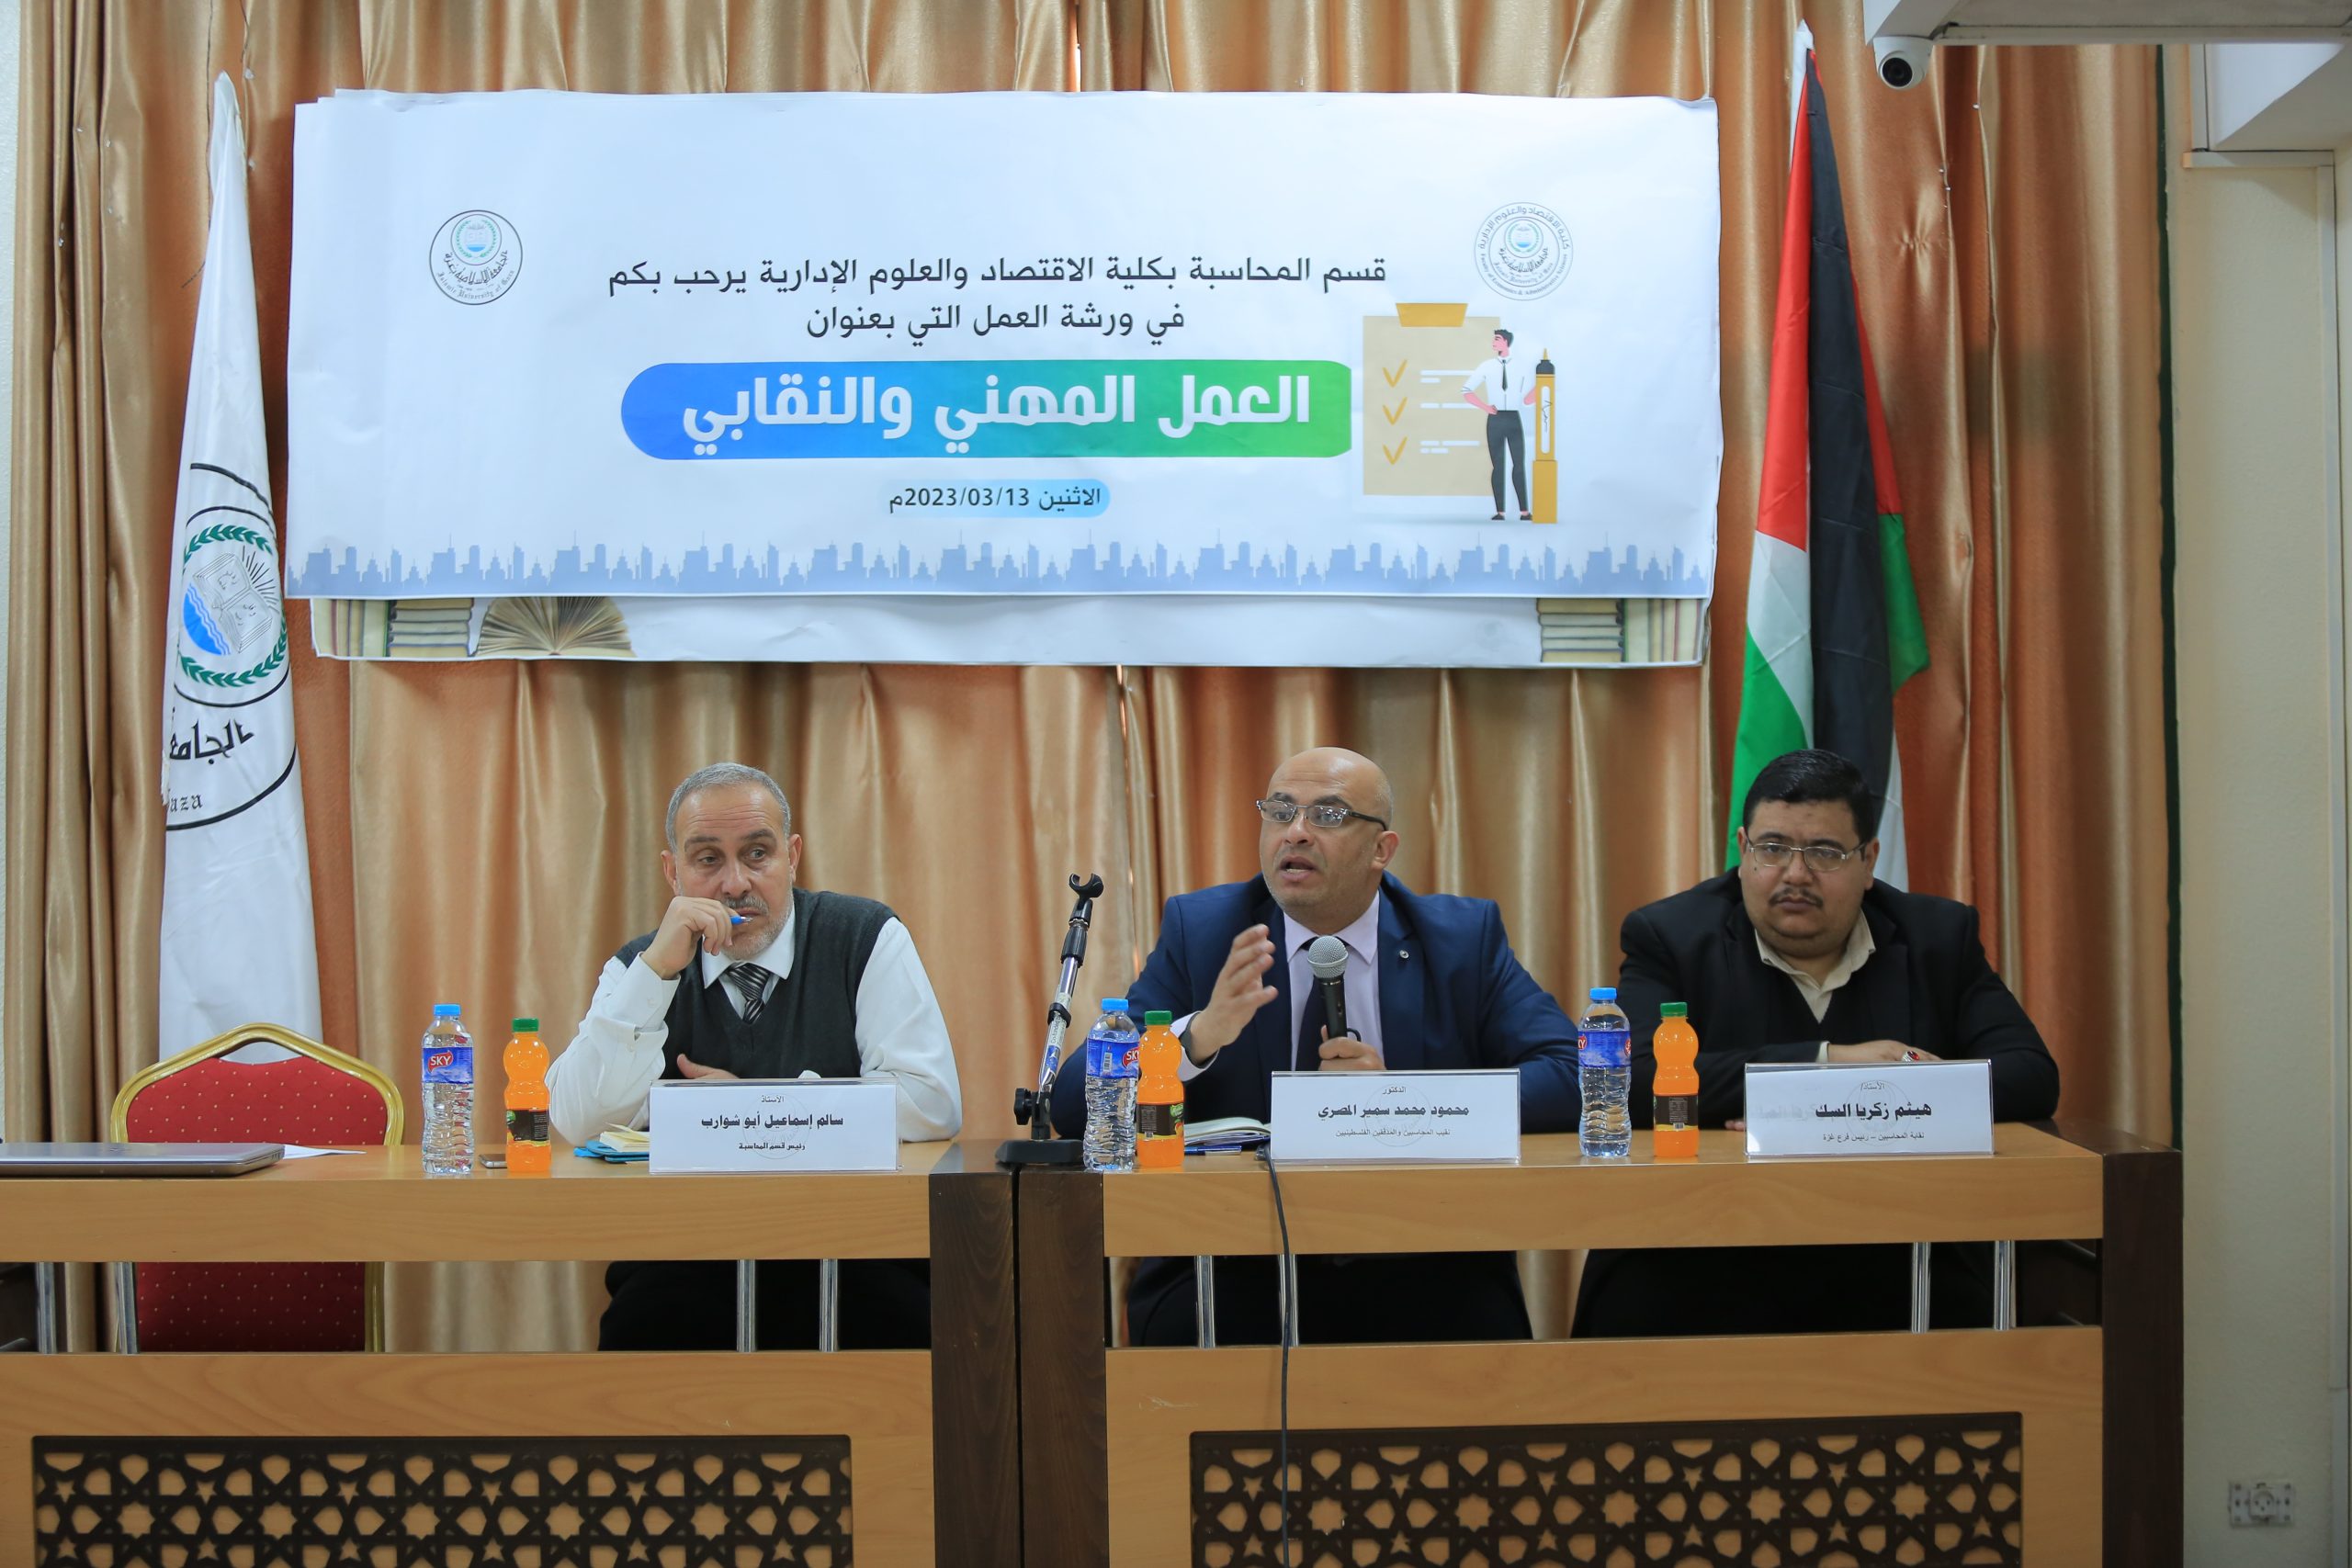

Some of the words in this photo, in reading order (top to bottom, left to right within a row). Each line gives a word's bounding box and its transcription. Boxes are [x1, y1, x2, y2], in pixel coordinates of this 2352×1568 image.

[760, 258, 857, 294] الإدارية
[869, 257, 968, 296] والعلوم
[980, 256, 1094, 283] الاقتصاد
[1106, 256, 1177, 290] بكلية
[1190, 256, 1311, 289] المحاسبة
[1323, 258, 1386, 293] قسم
[609, 260, 662, 298] بكم
[673, 267, 747, 295] يرحب
[806, 306, 895, 340] بعنوان
[908, 304, 961, 347] التي
[973, 304, 1048, 338] العمل
[1060, 301, 1134, 338] ورشة
[1146, 303, 1185, 347] في
[683, 373, 912, 456] والنقابي
[934, 374, 1136, 454] المهني
[1157, 375, 1310, 438] العمل
[1038, 486, 1101, 513] الاثنين
[169, 794, 203, 812] aza
[430, 1055, 452, 1066] SKY
[1381, 1086, 1407, 1096] الدكتور
[1317, 1104, 1357, 1122] المصري
[1359, 1107, 1390, 1119] سمير
[1394, 1106, 1427, 1116] محمد
[1430, 1106, 1470, 1119] محمود
[1855, 1101, 1890, 1121] زكريا
[1894, 1101, 1932, 1122] هيثم
[701, 1113, 741, 1130] شوارب
[742, 1111, 762, 1130] أبو
[763, 1113, 813, 1131] إسماعيل
[816, 1113, 844, 1131] سالم
[1403, 1128, 1435, 1138] المحاسبين
[1436, 1128, 1452, 1137] نقيب
[1823, 1133, 1836, 1143] غزة
[1837, 1132, 1849, 1144] فرع
[1851, 1133, 1870, 1143] رئيس
[1878, 1131, 1908, 1143] المحاسبين
[1909, 1131, 1926, 1141] نقابة
[738, 1142, 769, 1151] المحاسبة
[769, 1142, 786, 1151] قسم
[786, 1142, 806, 1152] رئيس
